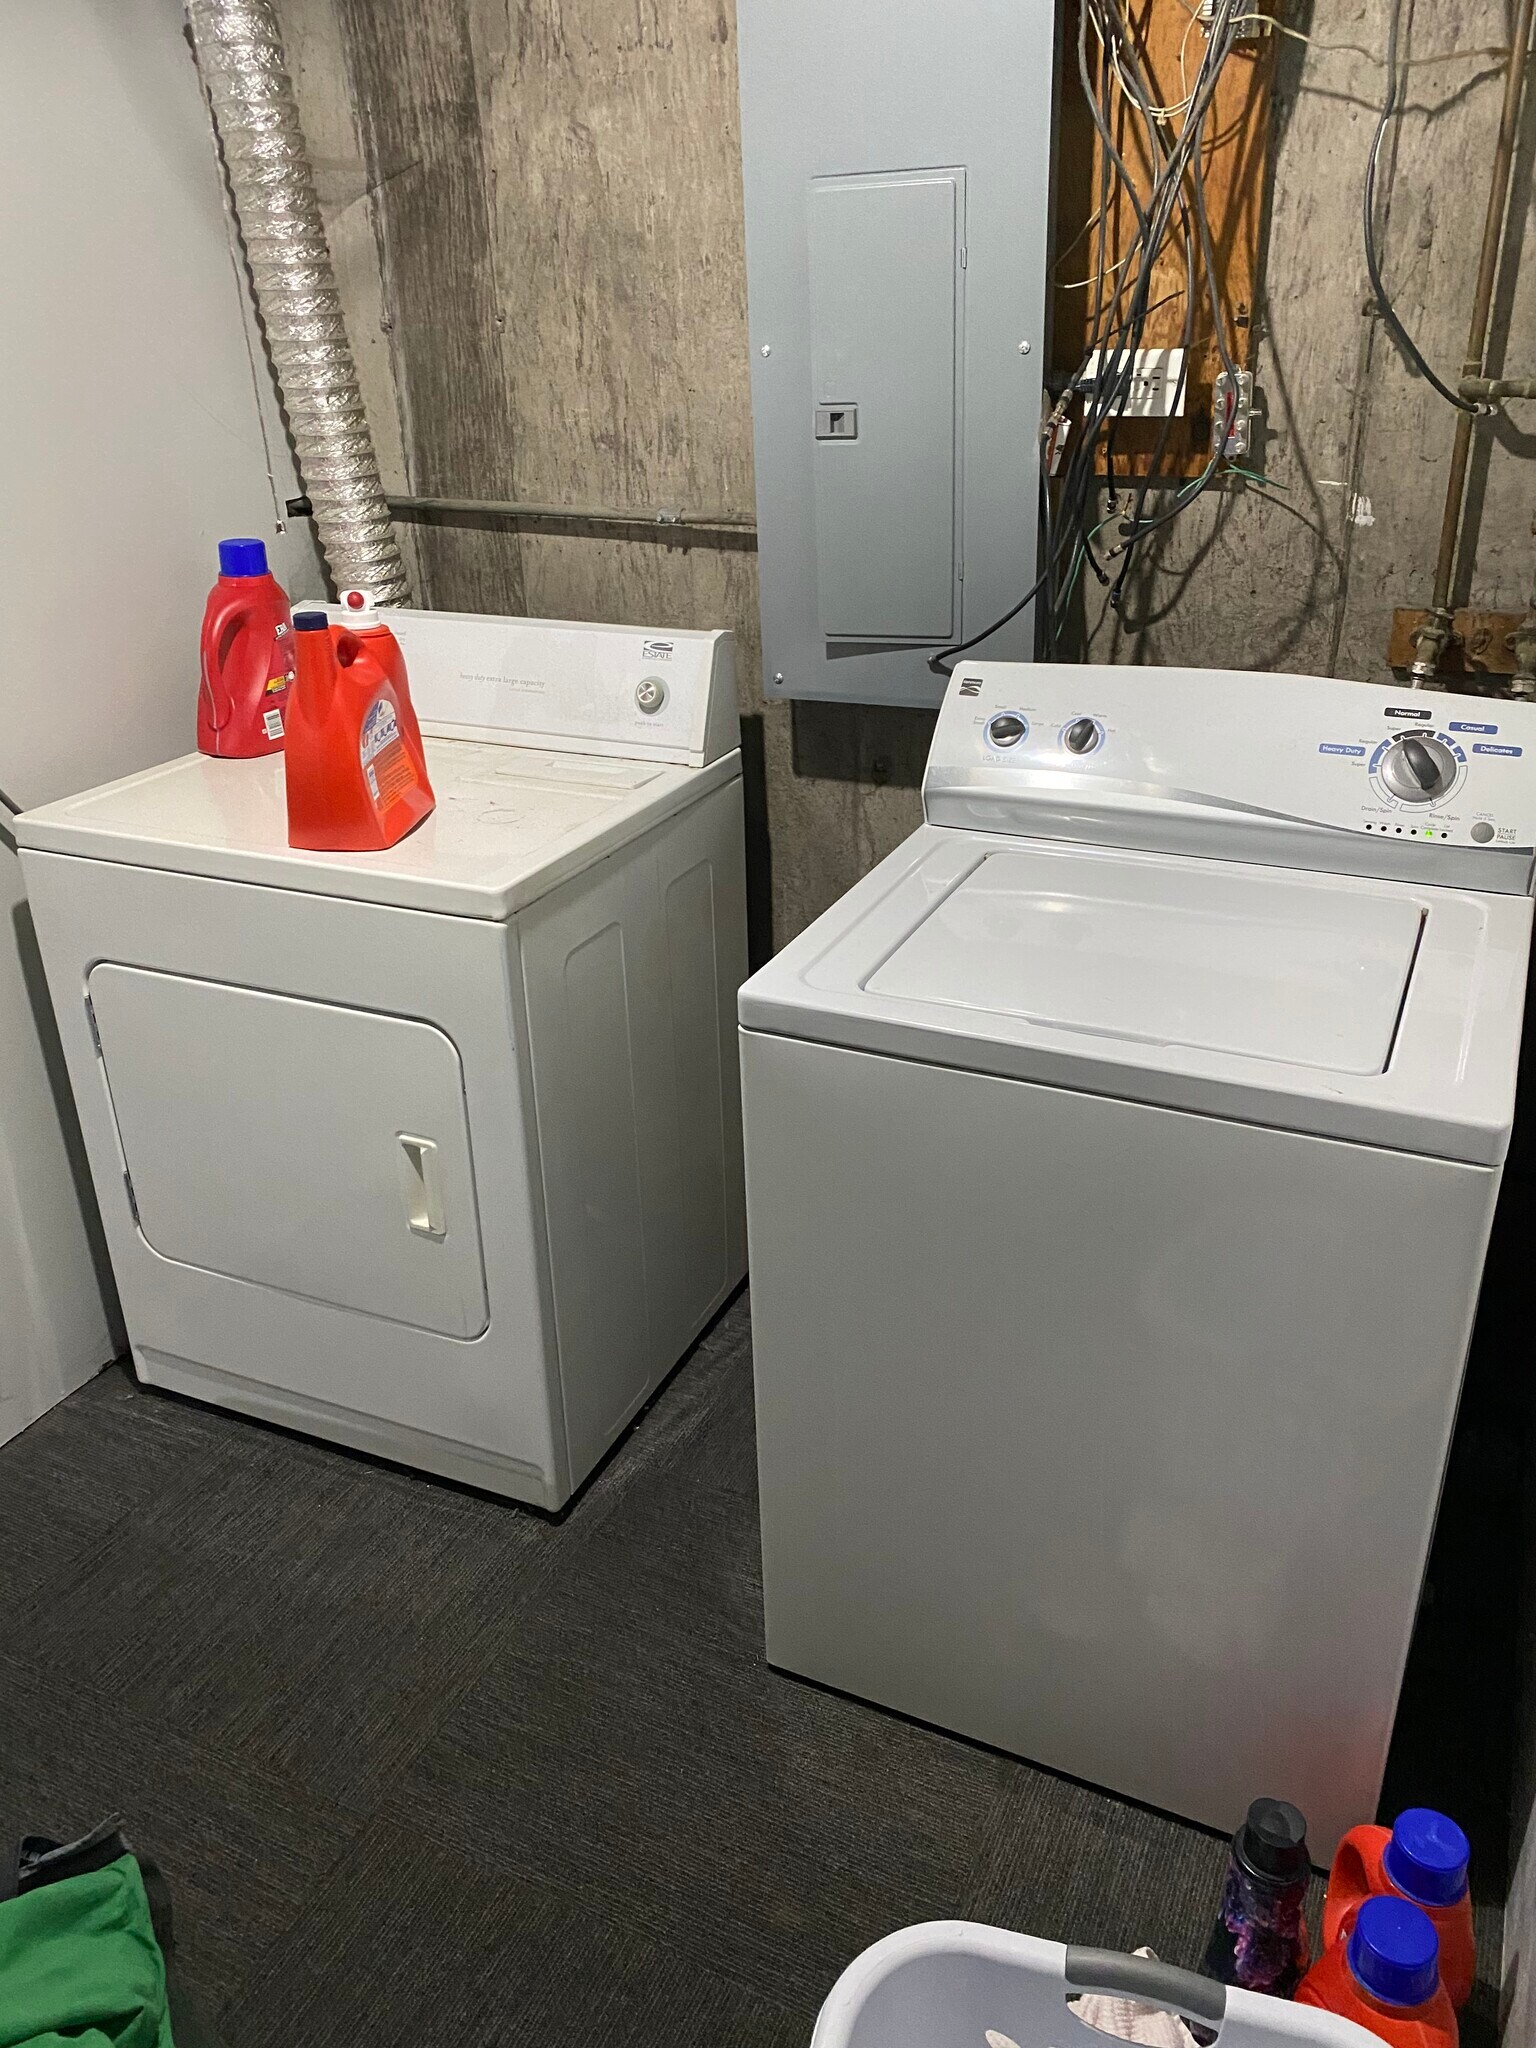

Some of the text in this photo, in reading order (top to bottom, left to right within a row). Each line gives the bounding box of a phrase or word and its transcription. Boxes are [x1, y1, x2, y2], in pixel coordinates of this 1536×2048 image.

[643, 650, 673, 659] ESTATE
[503, 676, 518, 686] large
[520, 679, 545, 688] capacity
[1394, 709, 1421, 718] Normal
[1414, 721, 1434, 729] Regular
[1460, 724, 1485, 732] Casual
[1322, 745, 1362, 756] Heavy Duty
[1480, 745, 1514, 755] Delicates
[1361, 805, 1393, 814] Drain/Spin
[1428, 812, 1460, 821] Rinse/Spin
